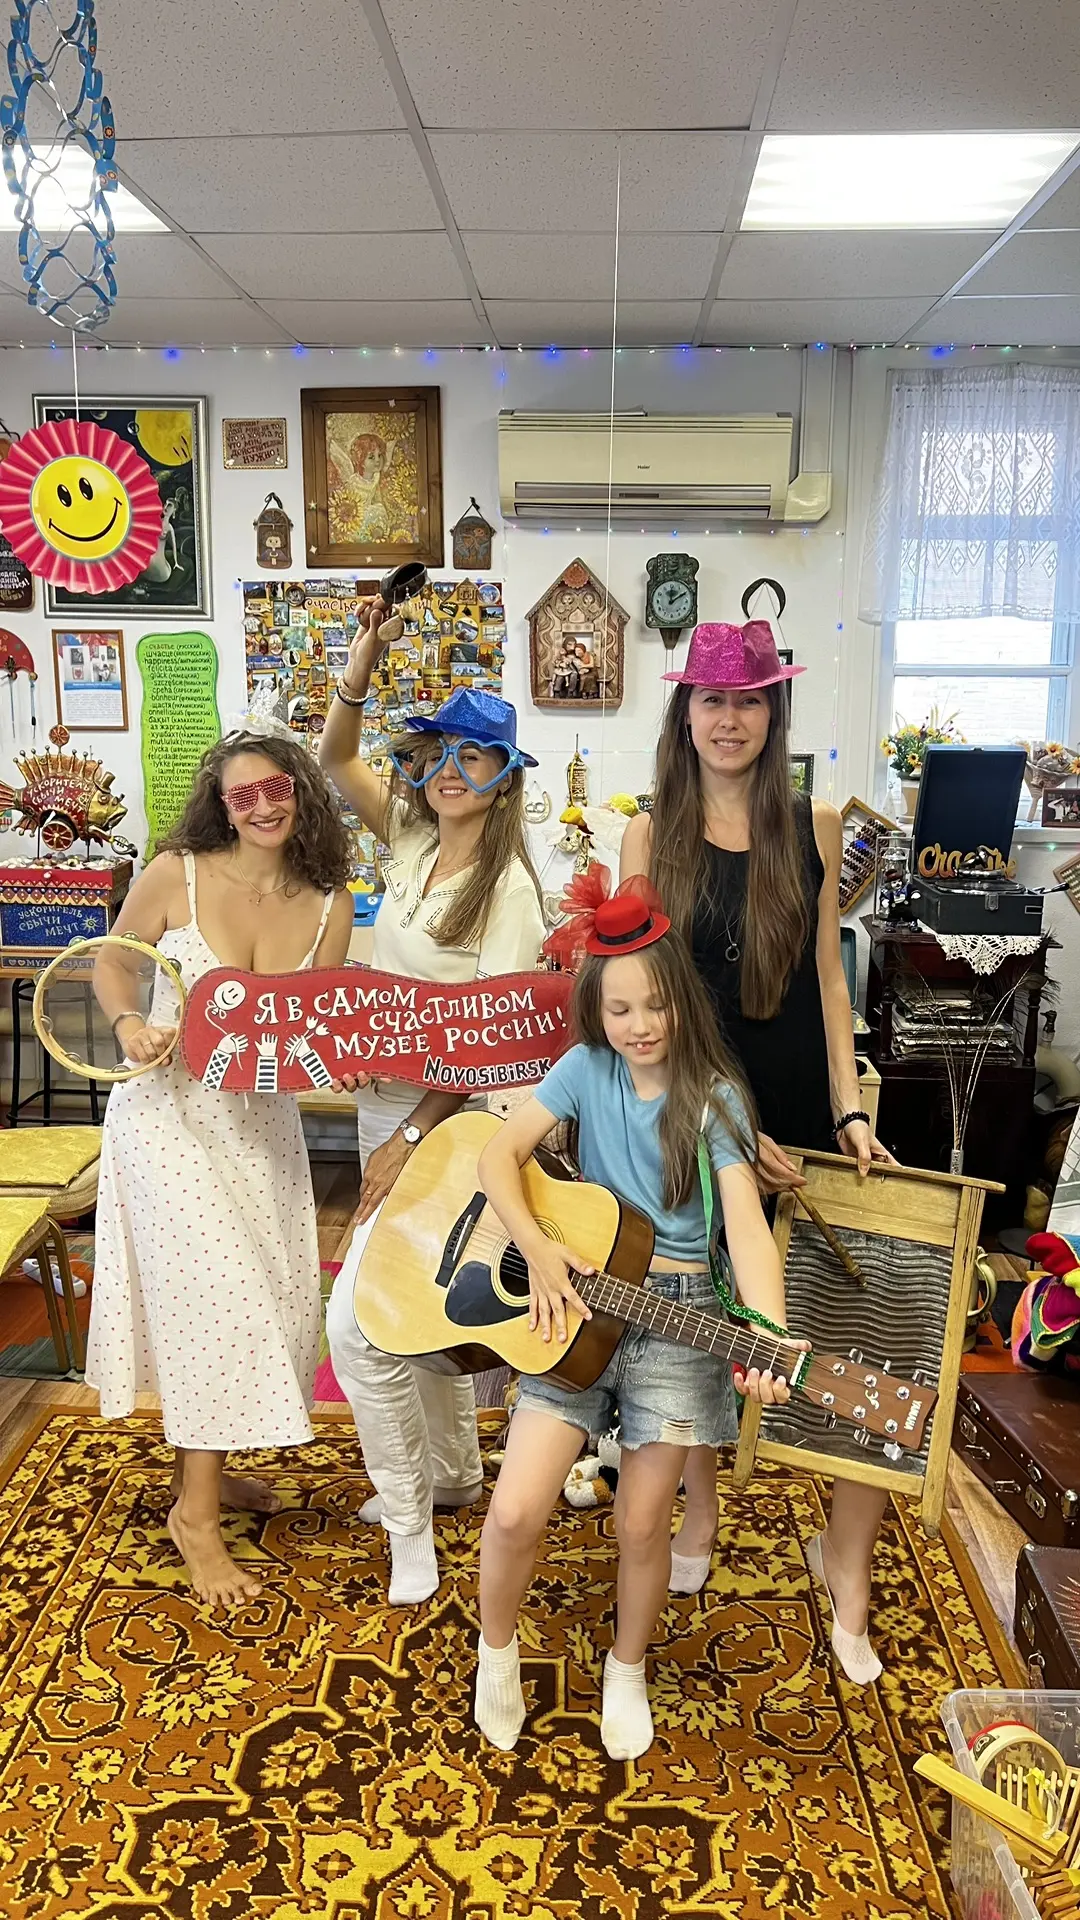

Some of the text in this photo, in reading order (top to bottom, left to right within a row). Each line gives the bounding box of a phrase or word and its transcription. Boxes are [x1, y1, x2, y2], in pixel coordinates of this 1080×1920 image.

[26, 777, 90, 798] УСКОРИТЕЛЬ
[32, 786, 64, 805] СБЫЧИ
[54, 795, 84, 813] МЕЧТ
[18, 905, 83, 919] УСКОРИТЕЛЬ
[19, 916, 60, 931] СБЫЧИ
[45, 922, 80, 936] МЕЧТ
[253, 985, 420, 1025] Я В САМОМ
[369, 987, 537, 1033] СЧАСТЛИВОМ
[333, 1006, 567, 1060] МУЗЕЕ РОССИИ!
[904, 1400, 922, 1431] YAMAHA
